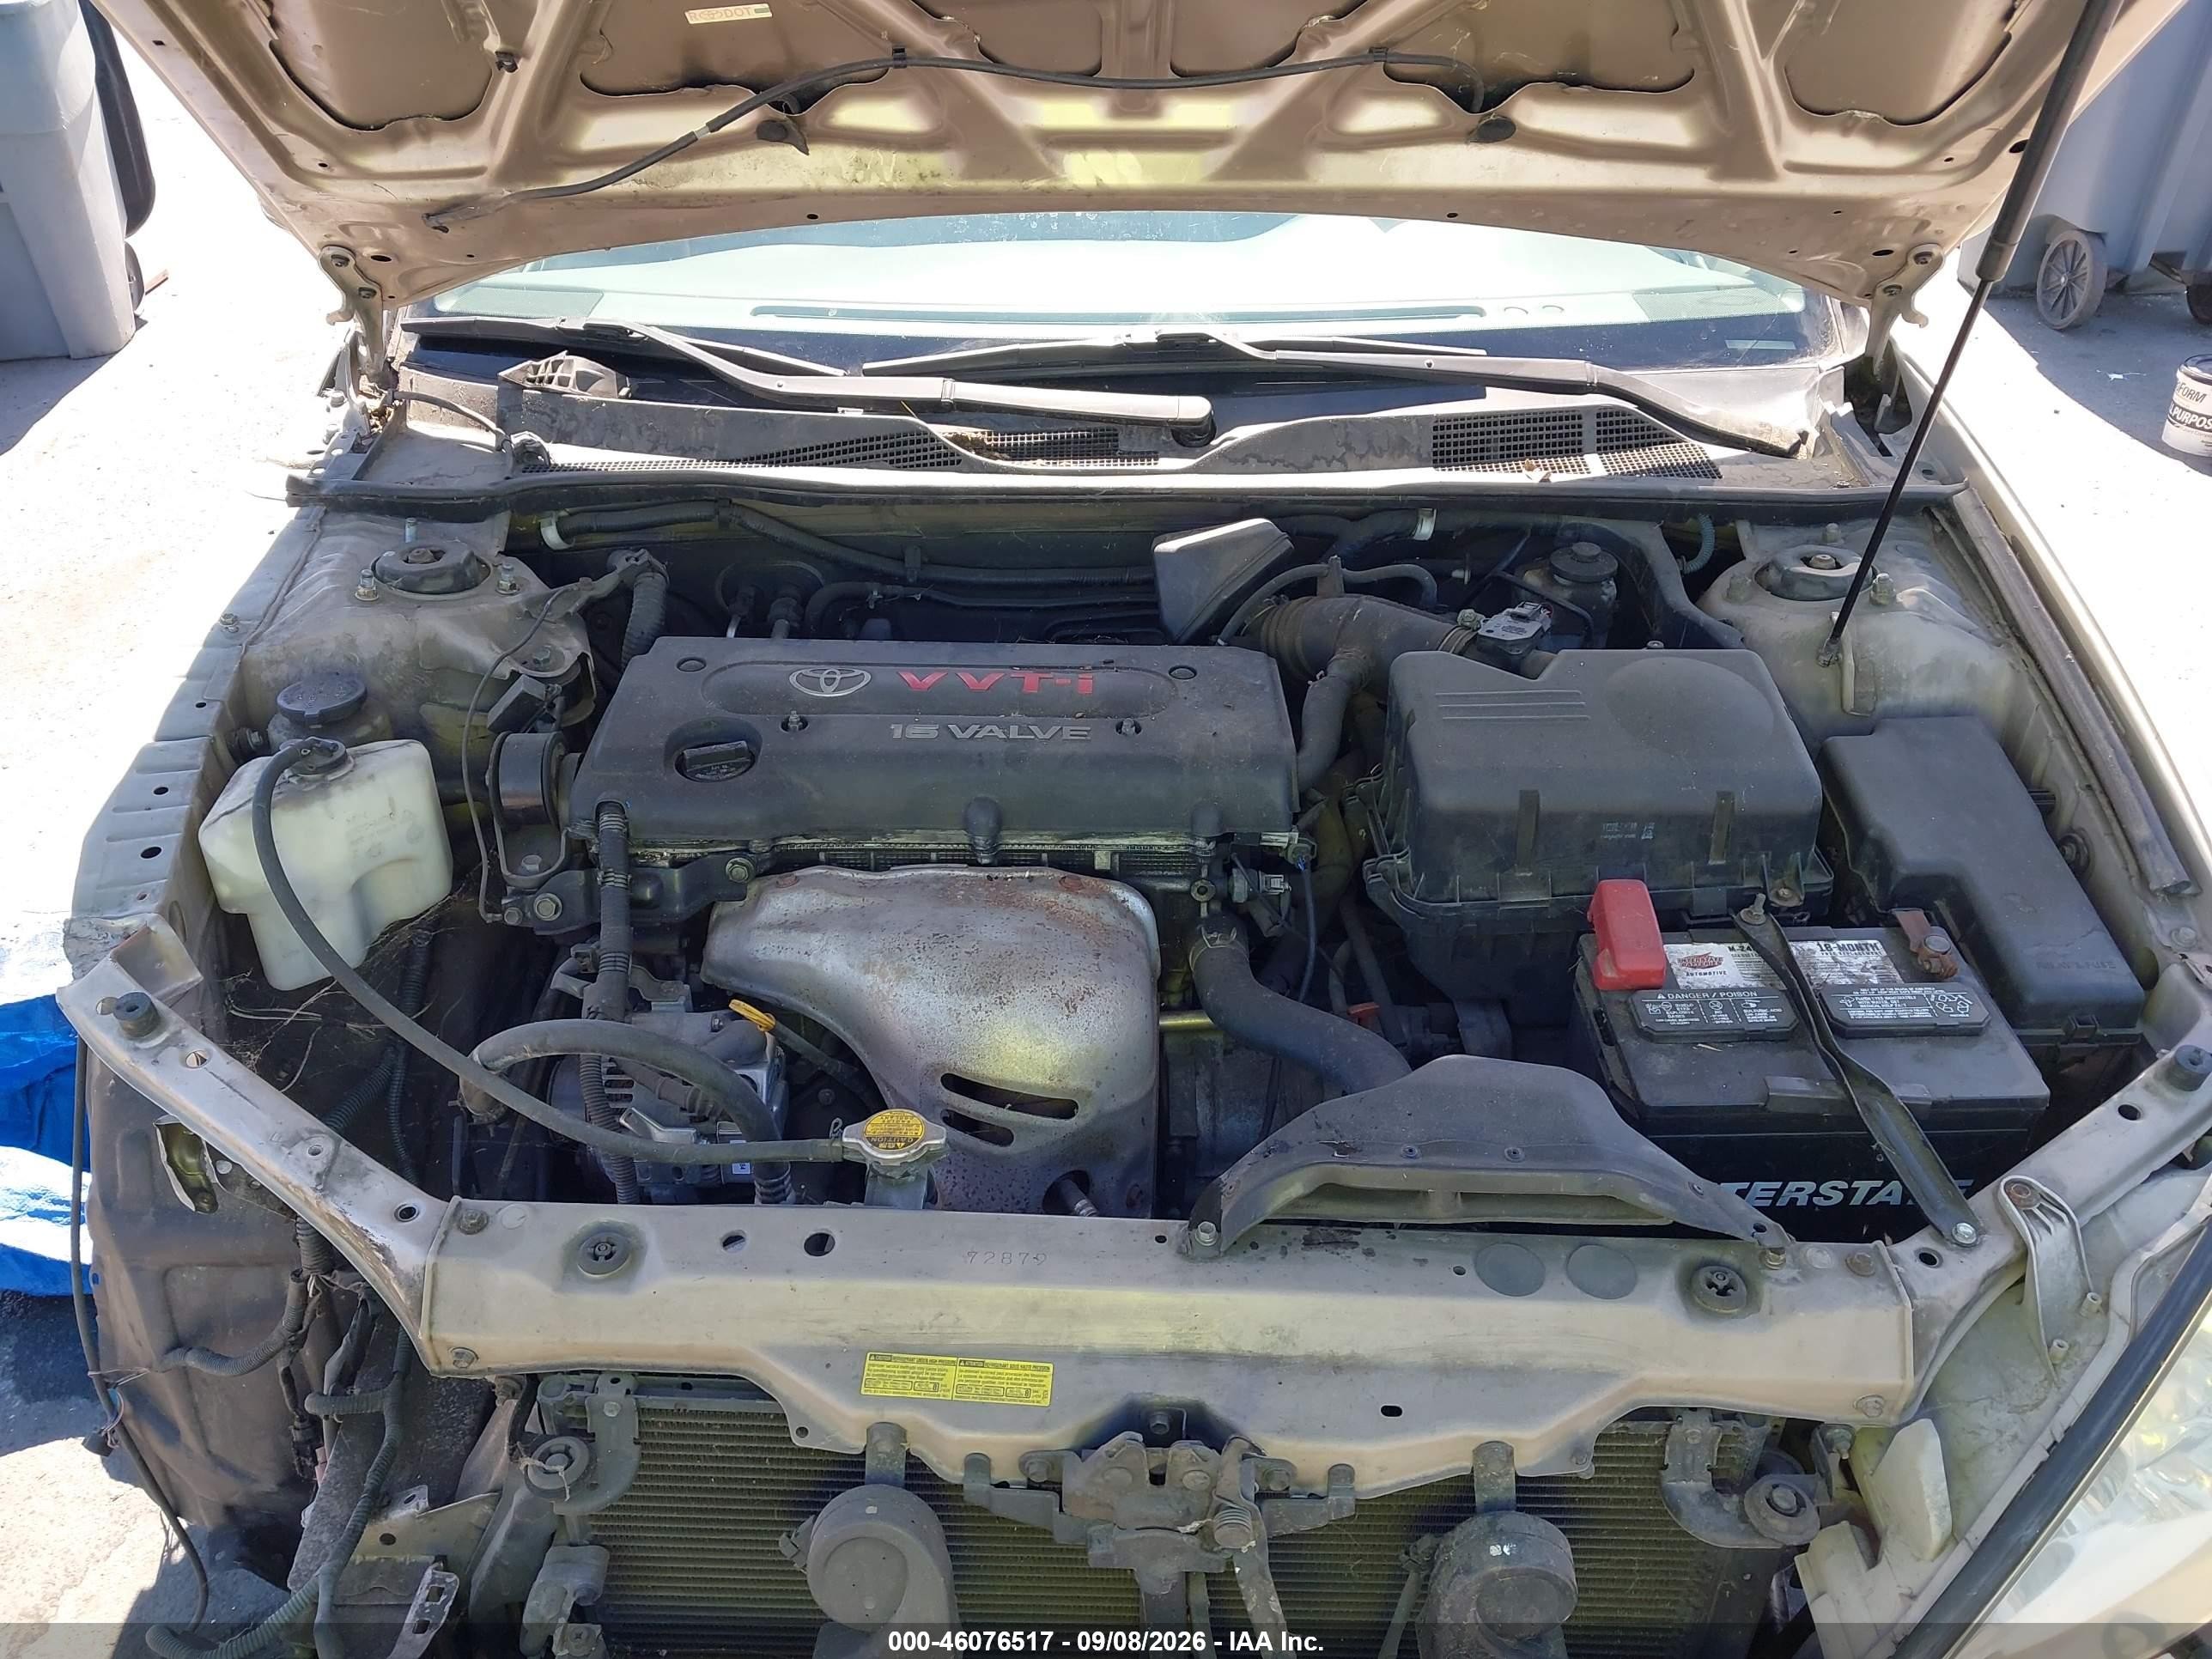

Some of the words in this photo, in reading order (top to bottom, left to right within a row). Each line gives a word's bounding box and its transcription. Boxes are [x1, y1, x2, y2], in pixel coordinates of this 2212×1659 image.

[725, 7, 751, 18] DOT
[2172, 406, 2212, 429] PURPOS
[898, 672, 1094, 694] VVT-i
[890, 723, 939, 738] 16
[947, 724, 1091, 740] VALVE
[1817, 942, 1881, 952] 18-MONTH
[1718, 1178, 1974, 1206] TERSTA
[967, 1251, 1048, 1266] 72879
